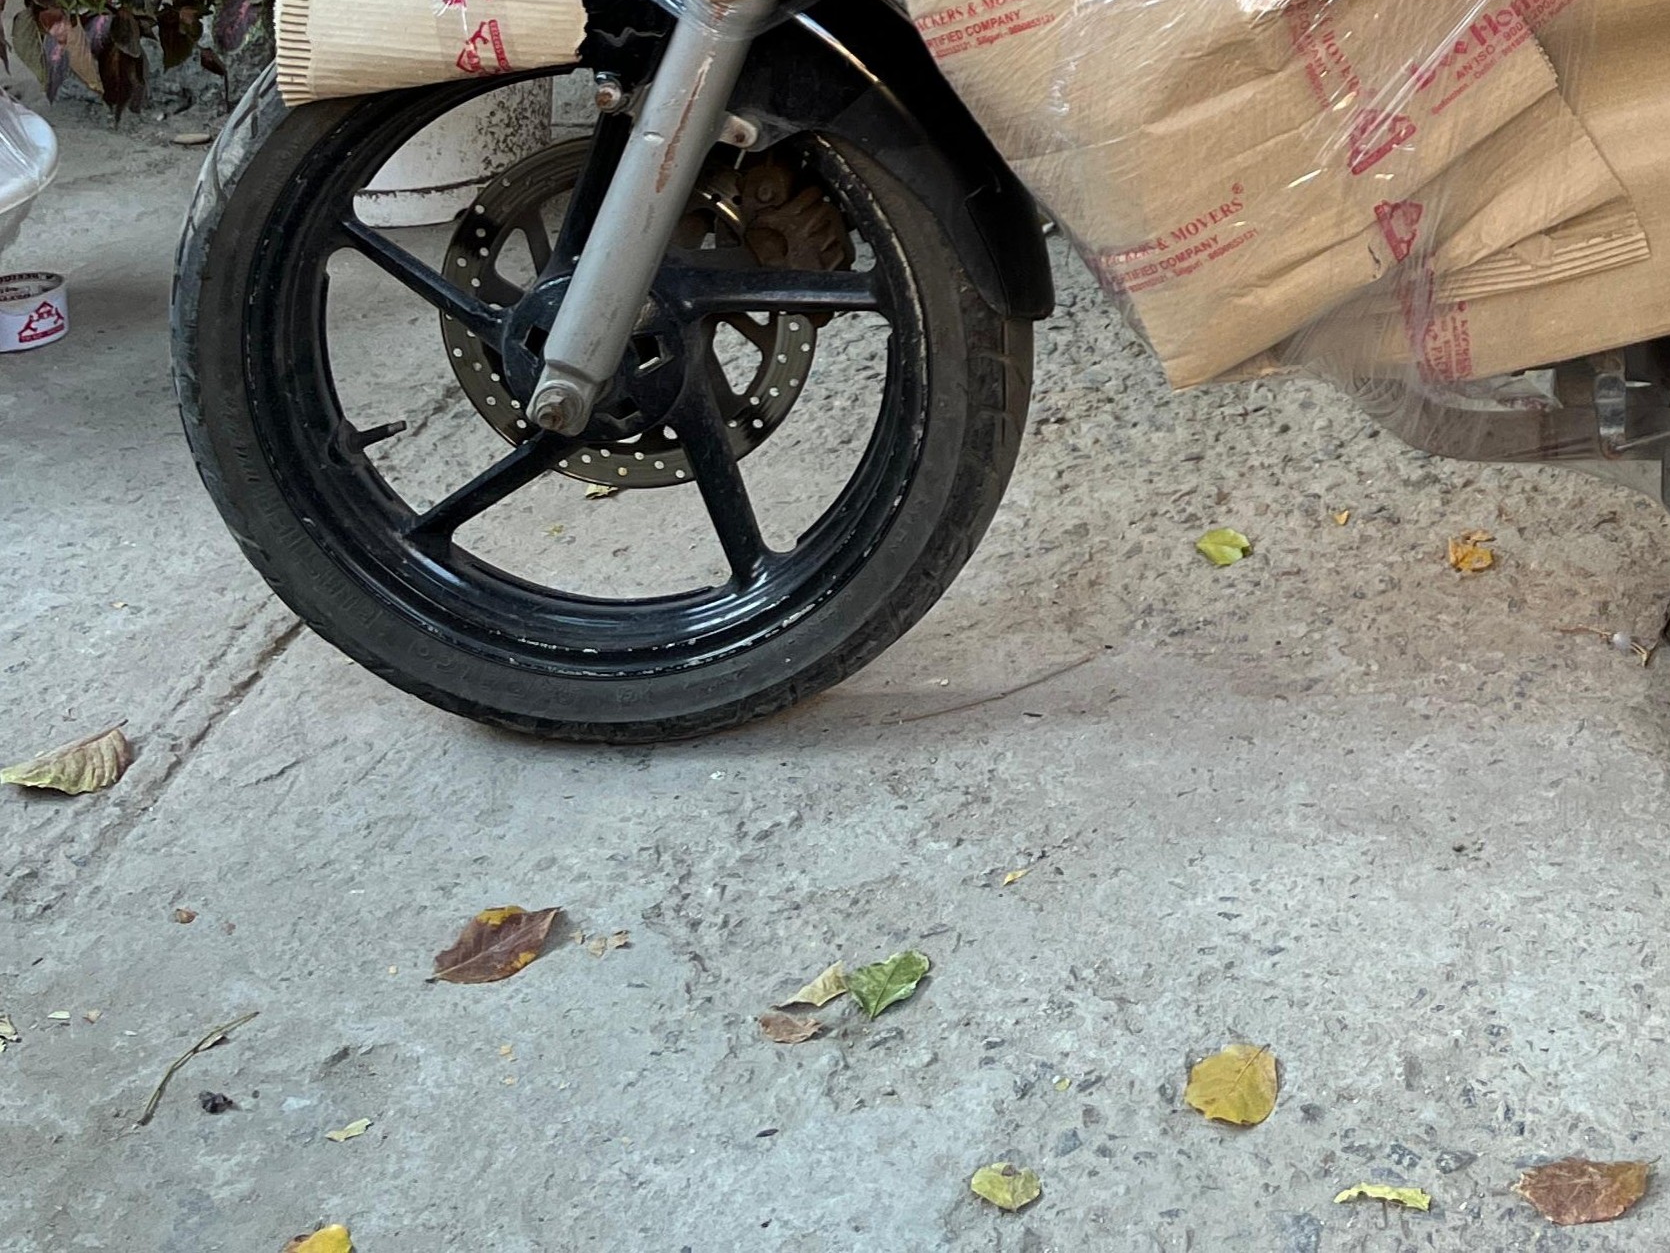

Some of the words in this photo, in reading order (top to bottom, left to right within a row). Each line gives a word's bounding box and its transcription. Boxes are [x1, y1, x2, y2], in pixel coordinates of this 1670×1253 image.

[914, 5, 965, 33] ACKERS
[966, 1, 978, 18] &
[925, 28, 965, 50] RTIFIED
[964, 7, 1022, 38] COMPANY
[1156, 235, 1169, 252] &
[1158, 233, 1221, 272] COMPANY
